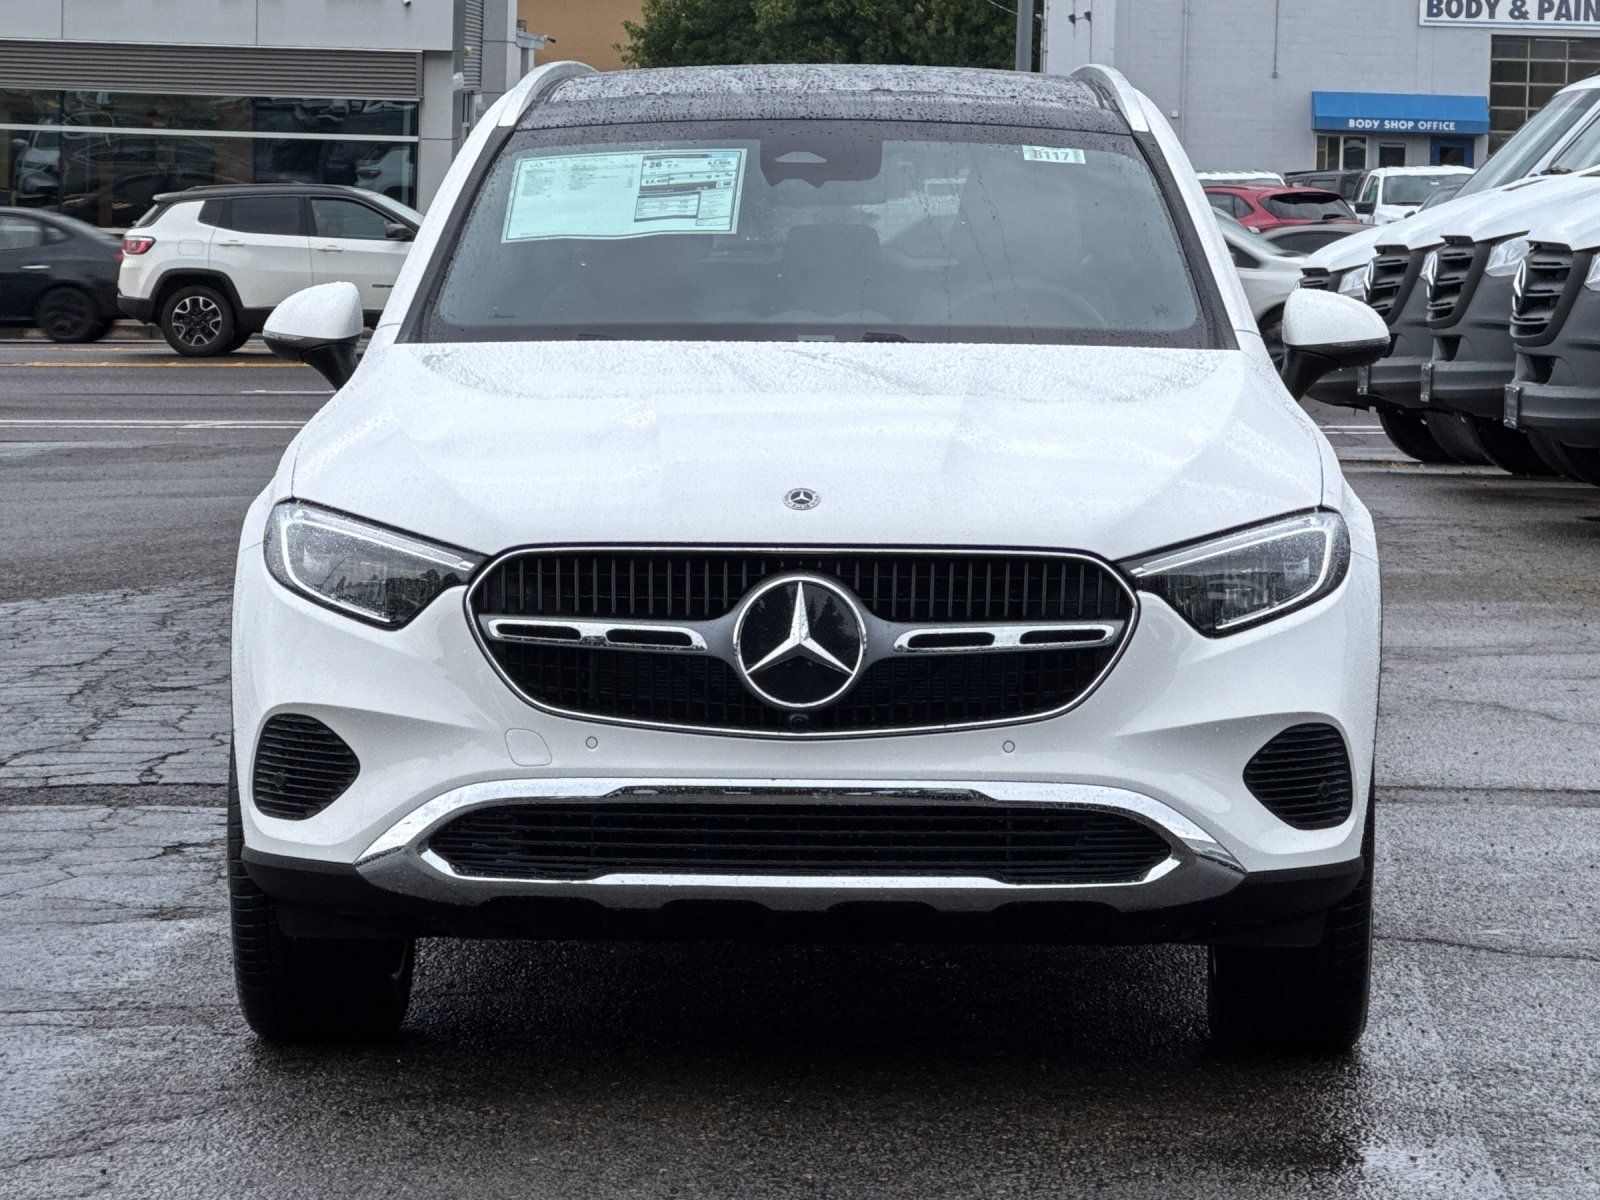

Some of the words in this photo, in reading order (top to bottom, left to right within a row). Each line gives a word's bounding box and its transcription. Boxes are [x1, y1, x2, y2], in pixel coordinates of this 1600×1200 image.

[1426, 0, 1500, 20] BODY
[1508, 0, 1530, 20] &
[1537, 0, 1600, 22] PAIN
[1348, 118, 1380, 129] BODY
[1384, 119, 1415, 130] SHOP
[1417, 120, 1456, 131] OFFICE
